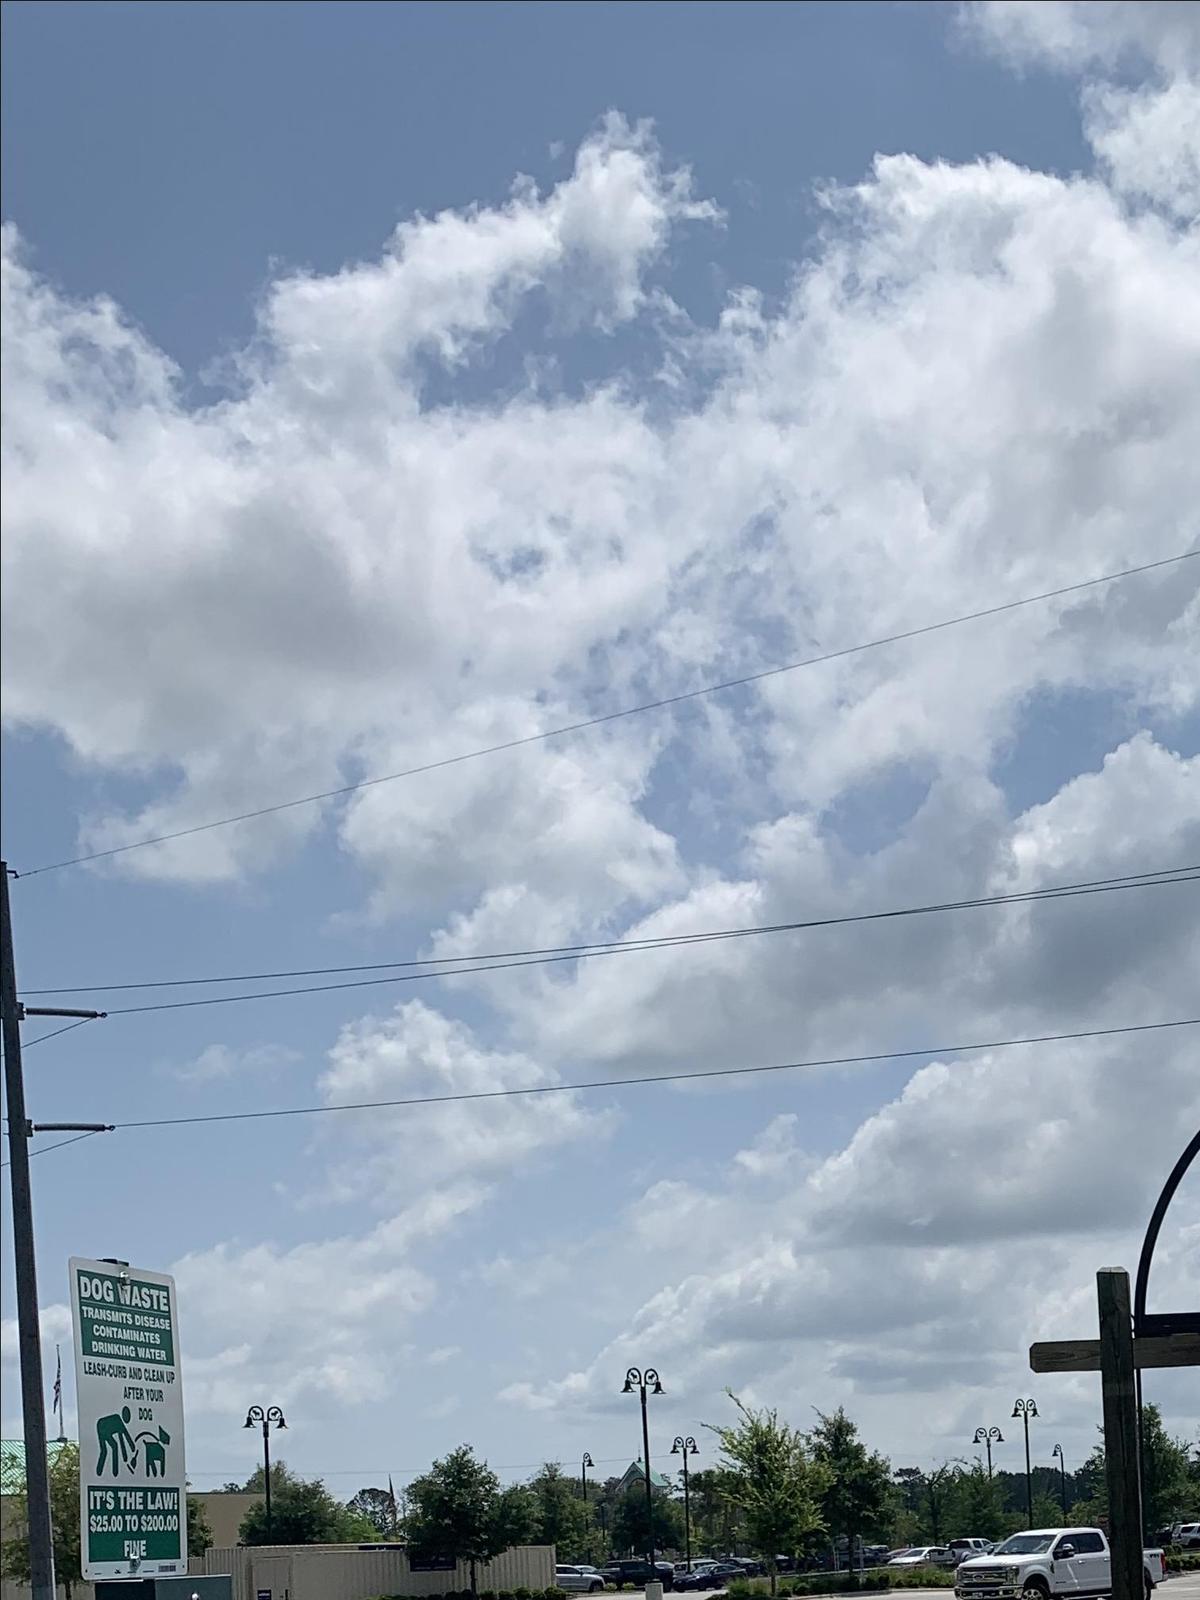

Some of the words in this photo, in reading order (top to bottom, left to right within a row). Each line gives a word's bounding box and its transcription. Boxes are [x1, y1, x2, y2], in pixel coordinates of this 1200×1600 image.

[80, 1276, 114, 1303] DOG
[117, 1283, 169, 1311] WASTE
[81, 1306, 133, 1325] TRANSMITS
[134, 1314, 171, 1330] DISEASE
[93, 1324, 161, 1345] CONTAMINATES
[91, 1341, 136, 1357] DRINKING
[136, 1346, 167, 1361] WATER
[83, 1361, 127, 1379] LEASH-CURB
[128, 1366, 142, 1381] AND
[143, 1368, 165, 1383] CLEAN
[165, 1371, 175, 1384] UP
[123, 1386, 145, 1401] AFTER
[145, 1389, 164, 1402] YOUR
[138, 1408, 153, 1421] DOG
[89, 1490, 115, 1510] IT'S
[118, 1491, 144, 1510] THE
[147, 1491, 178, 1510] LAW!
[89, 1514, 123, 1533] $25.00
[124, 1515, 139, 1532] TO
[140, 1514, 178, 1532] $200.00
[123, 1540, 147, 1558] FINE
